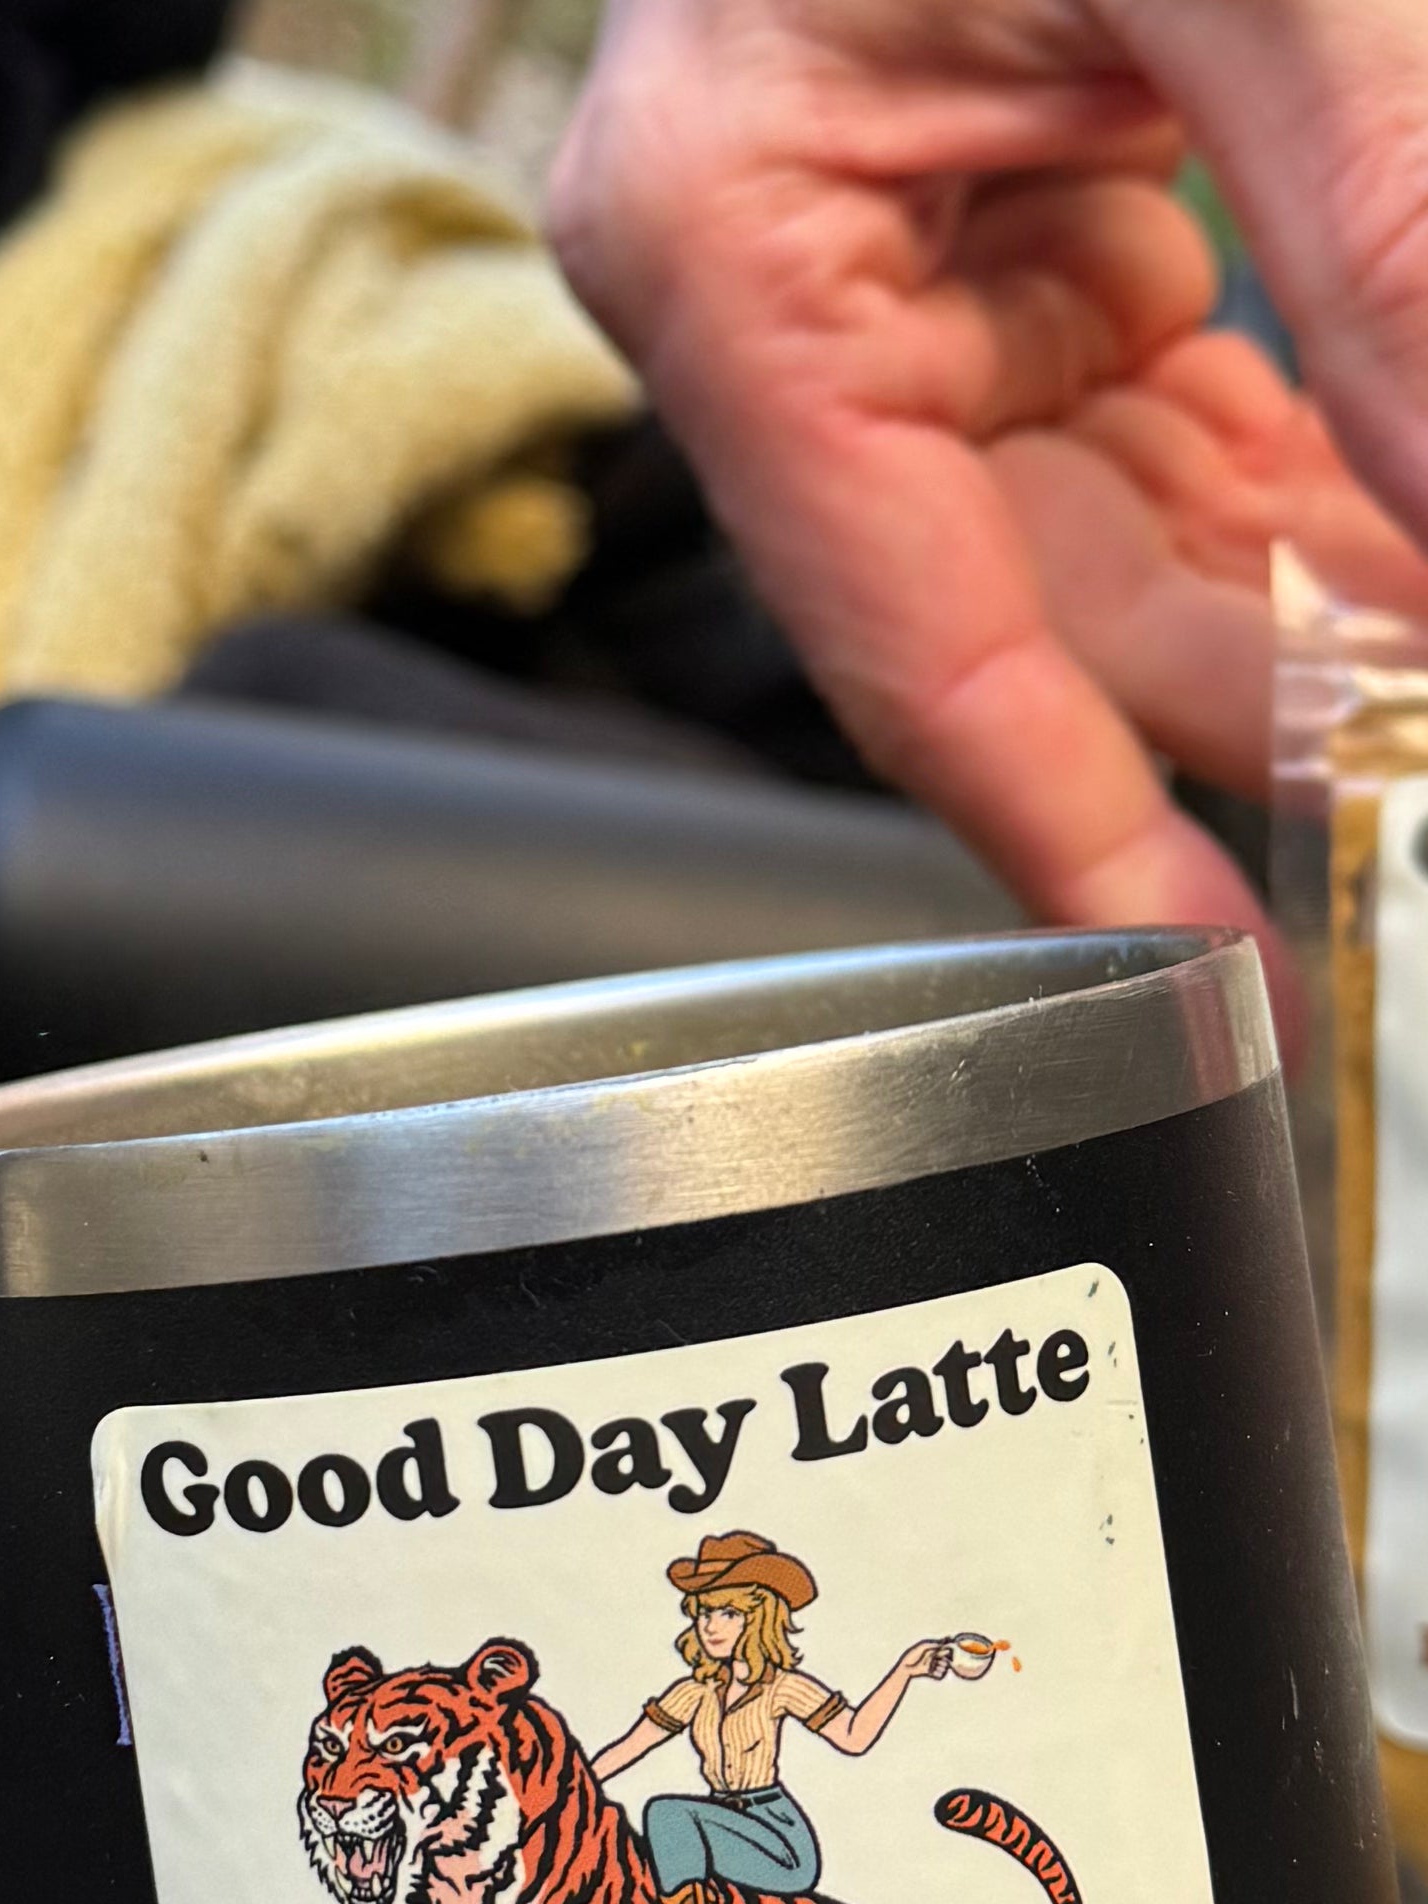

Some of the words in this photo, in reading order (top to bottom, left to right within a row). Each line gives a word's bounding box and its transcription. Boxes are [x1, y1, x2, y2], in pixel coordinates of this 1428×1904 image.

[140, 1418, 461, 1537] Good
[477, 1398, 757, 1514] Day
[779, 1328, 1091, 1463] Latte
